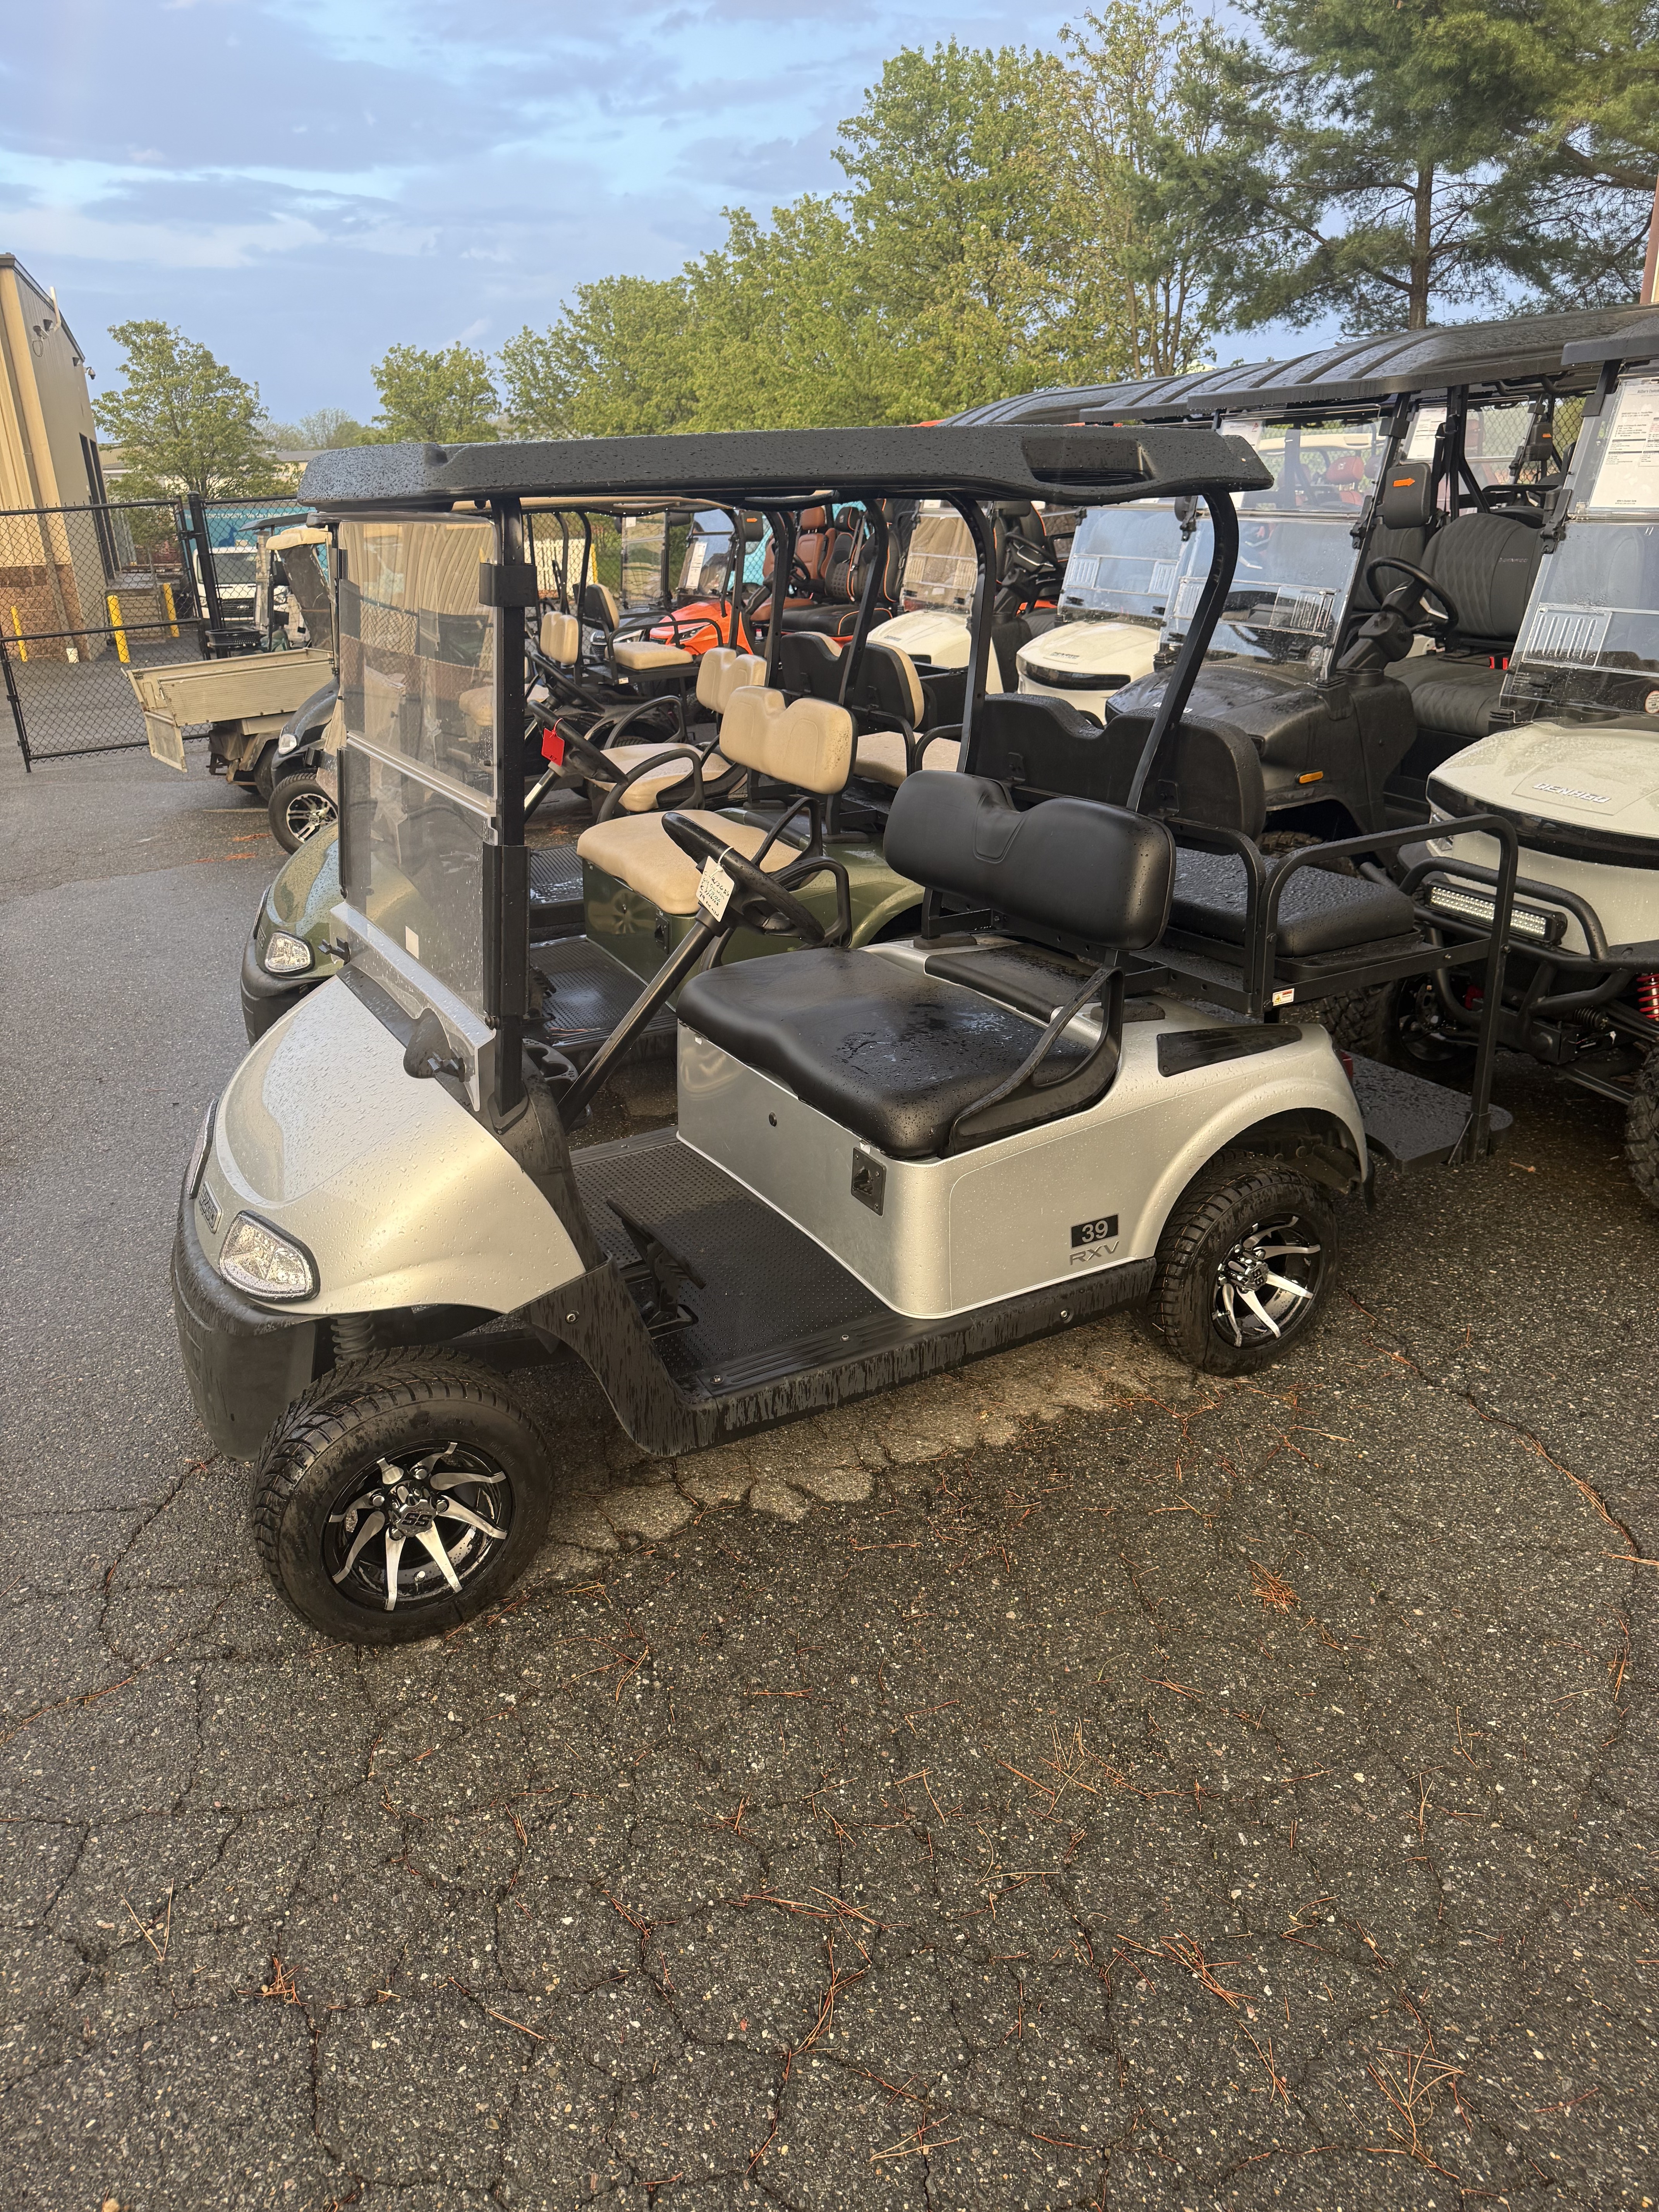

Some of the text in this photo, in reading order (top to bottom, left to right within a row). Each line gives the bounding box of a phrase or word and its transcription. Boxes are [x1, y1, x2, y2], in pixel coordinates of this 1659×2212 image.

[1532, 783, 1612, 803] DENAGO
[1082, 1220, 1108, 1243] 39
[1069, 1240, 1120, 1265] RXV
[401, 1512, 433, 1527] SS
